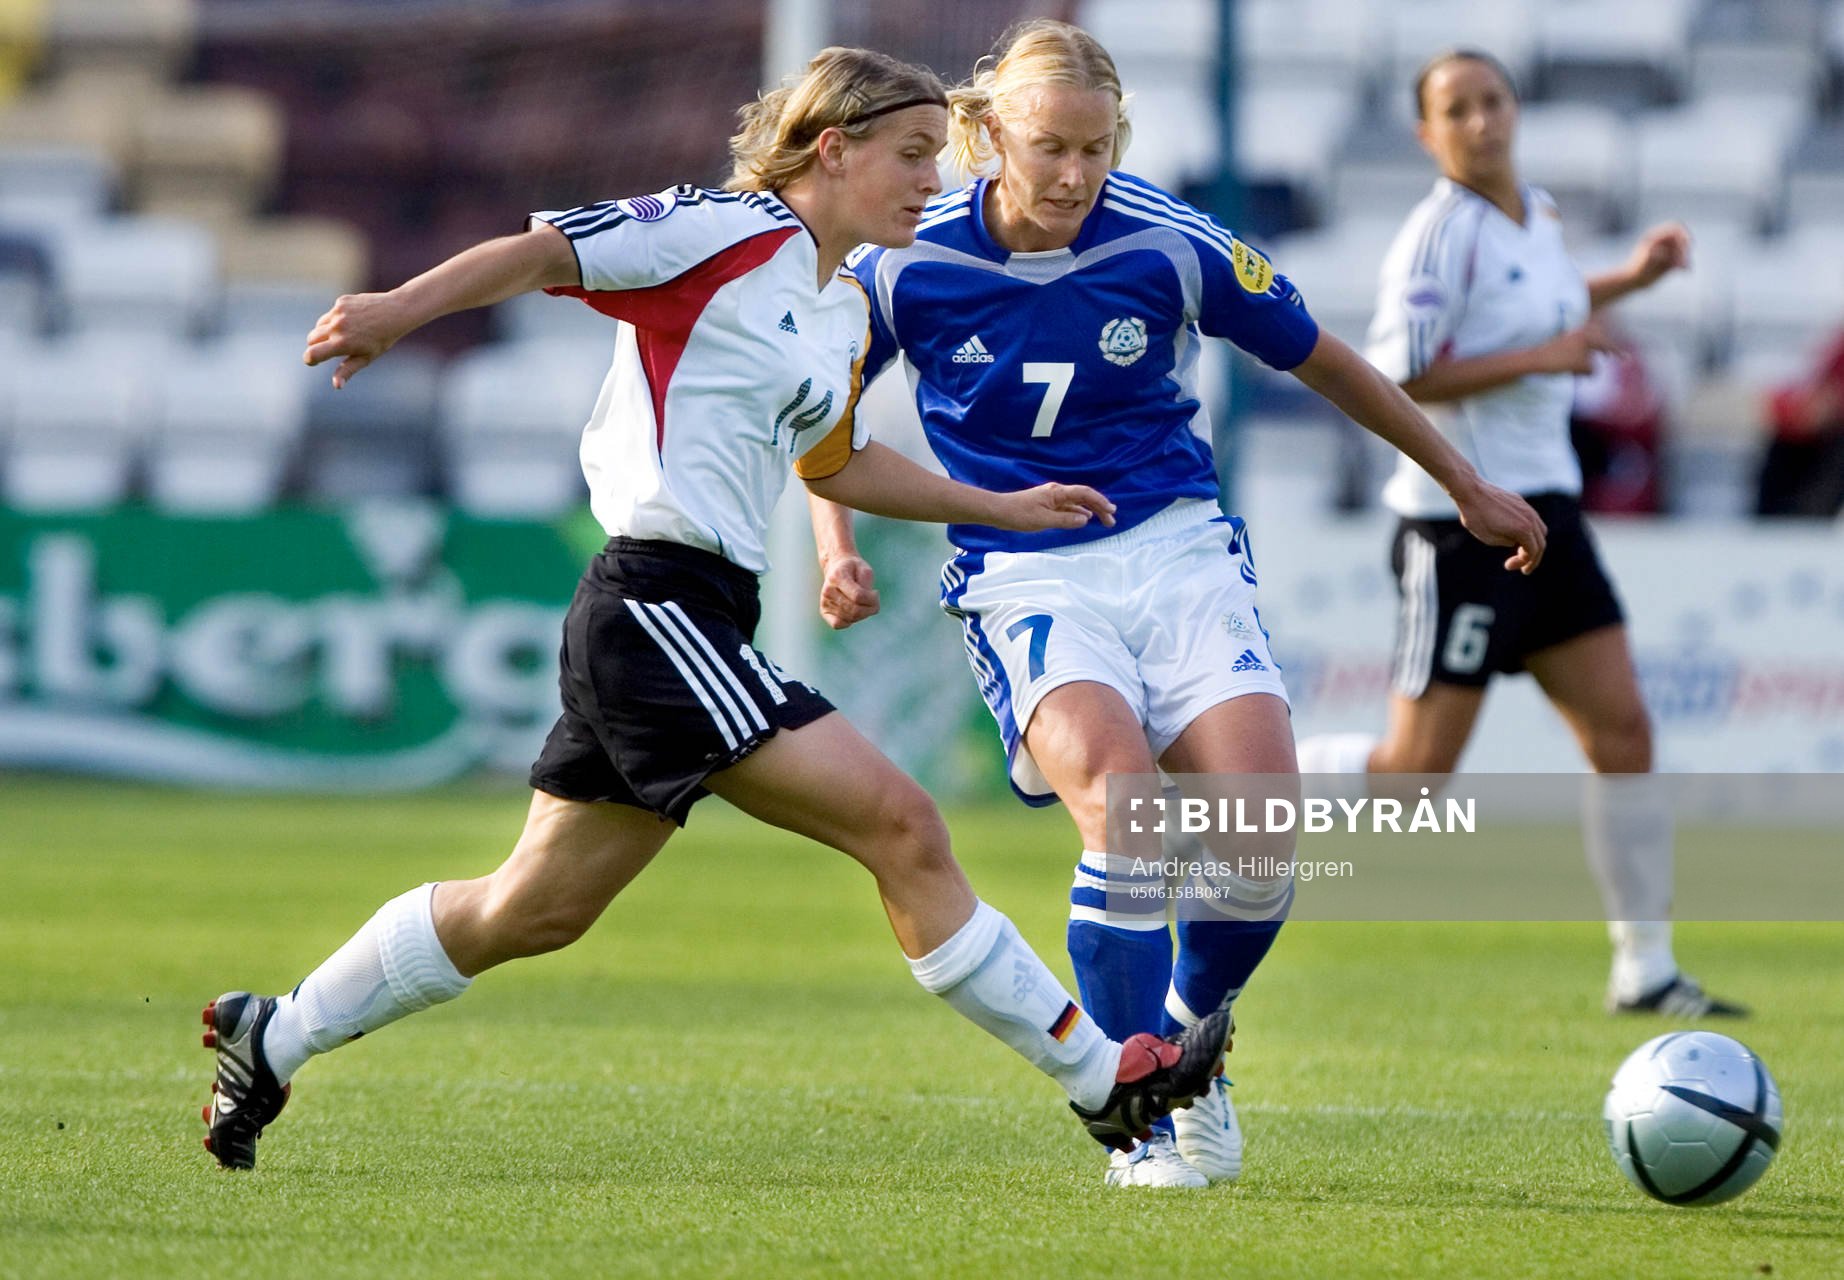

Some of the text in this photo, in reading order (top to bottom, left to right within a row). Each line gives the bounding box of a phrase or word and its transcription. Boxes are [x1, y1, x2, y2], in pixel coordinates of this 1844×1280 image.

[952, 353, 995, 363] adidas
[1022, 362, 1075, 437] 7
[0, 531, 566, 772] berg
[1006, 614, 1053, 683] 7
[1442, 603, 1495, 674] 6
